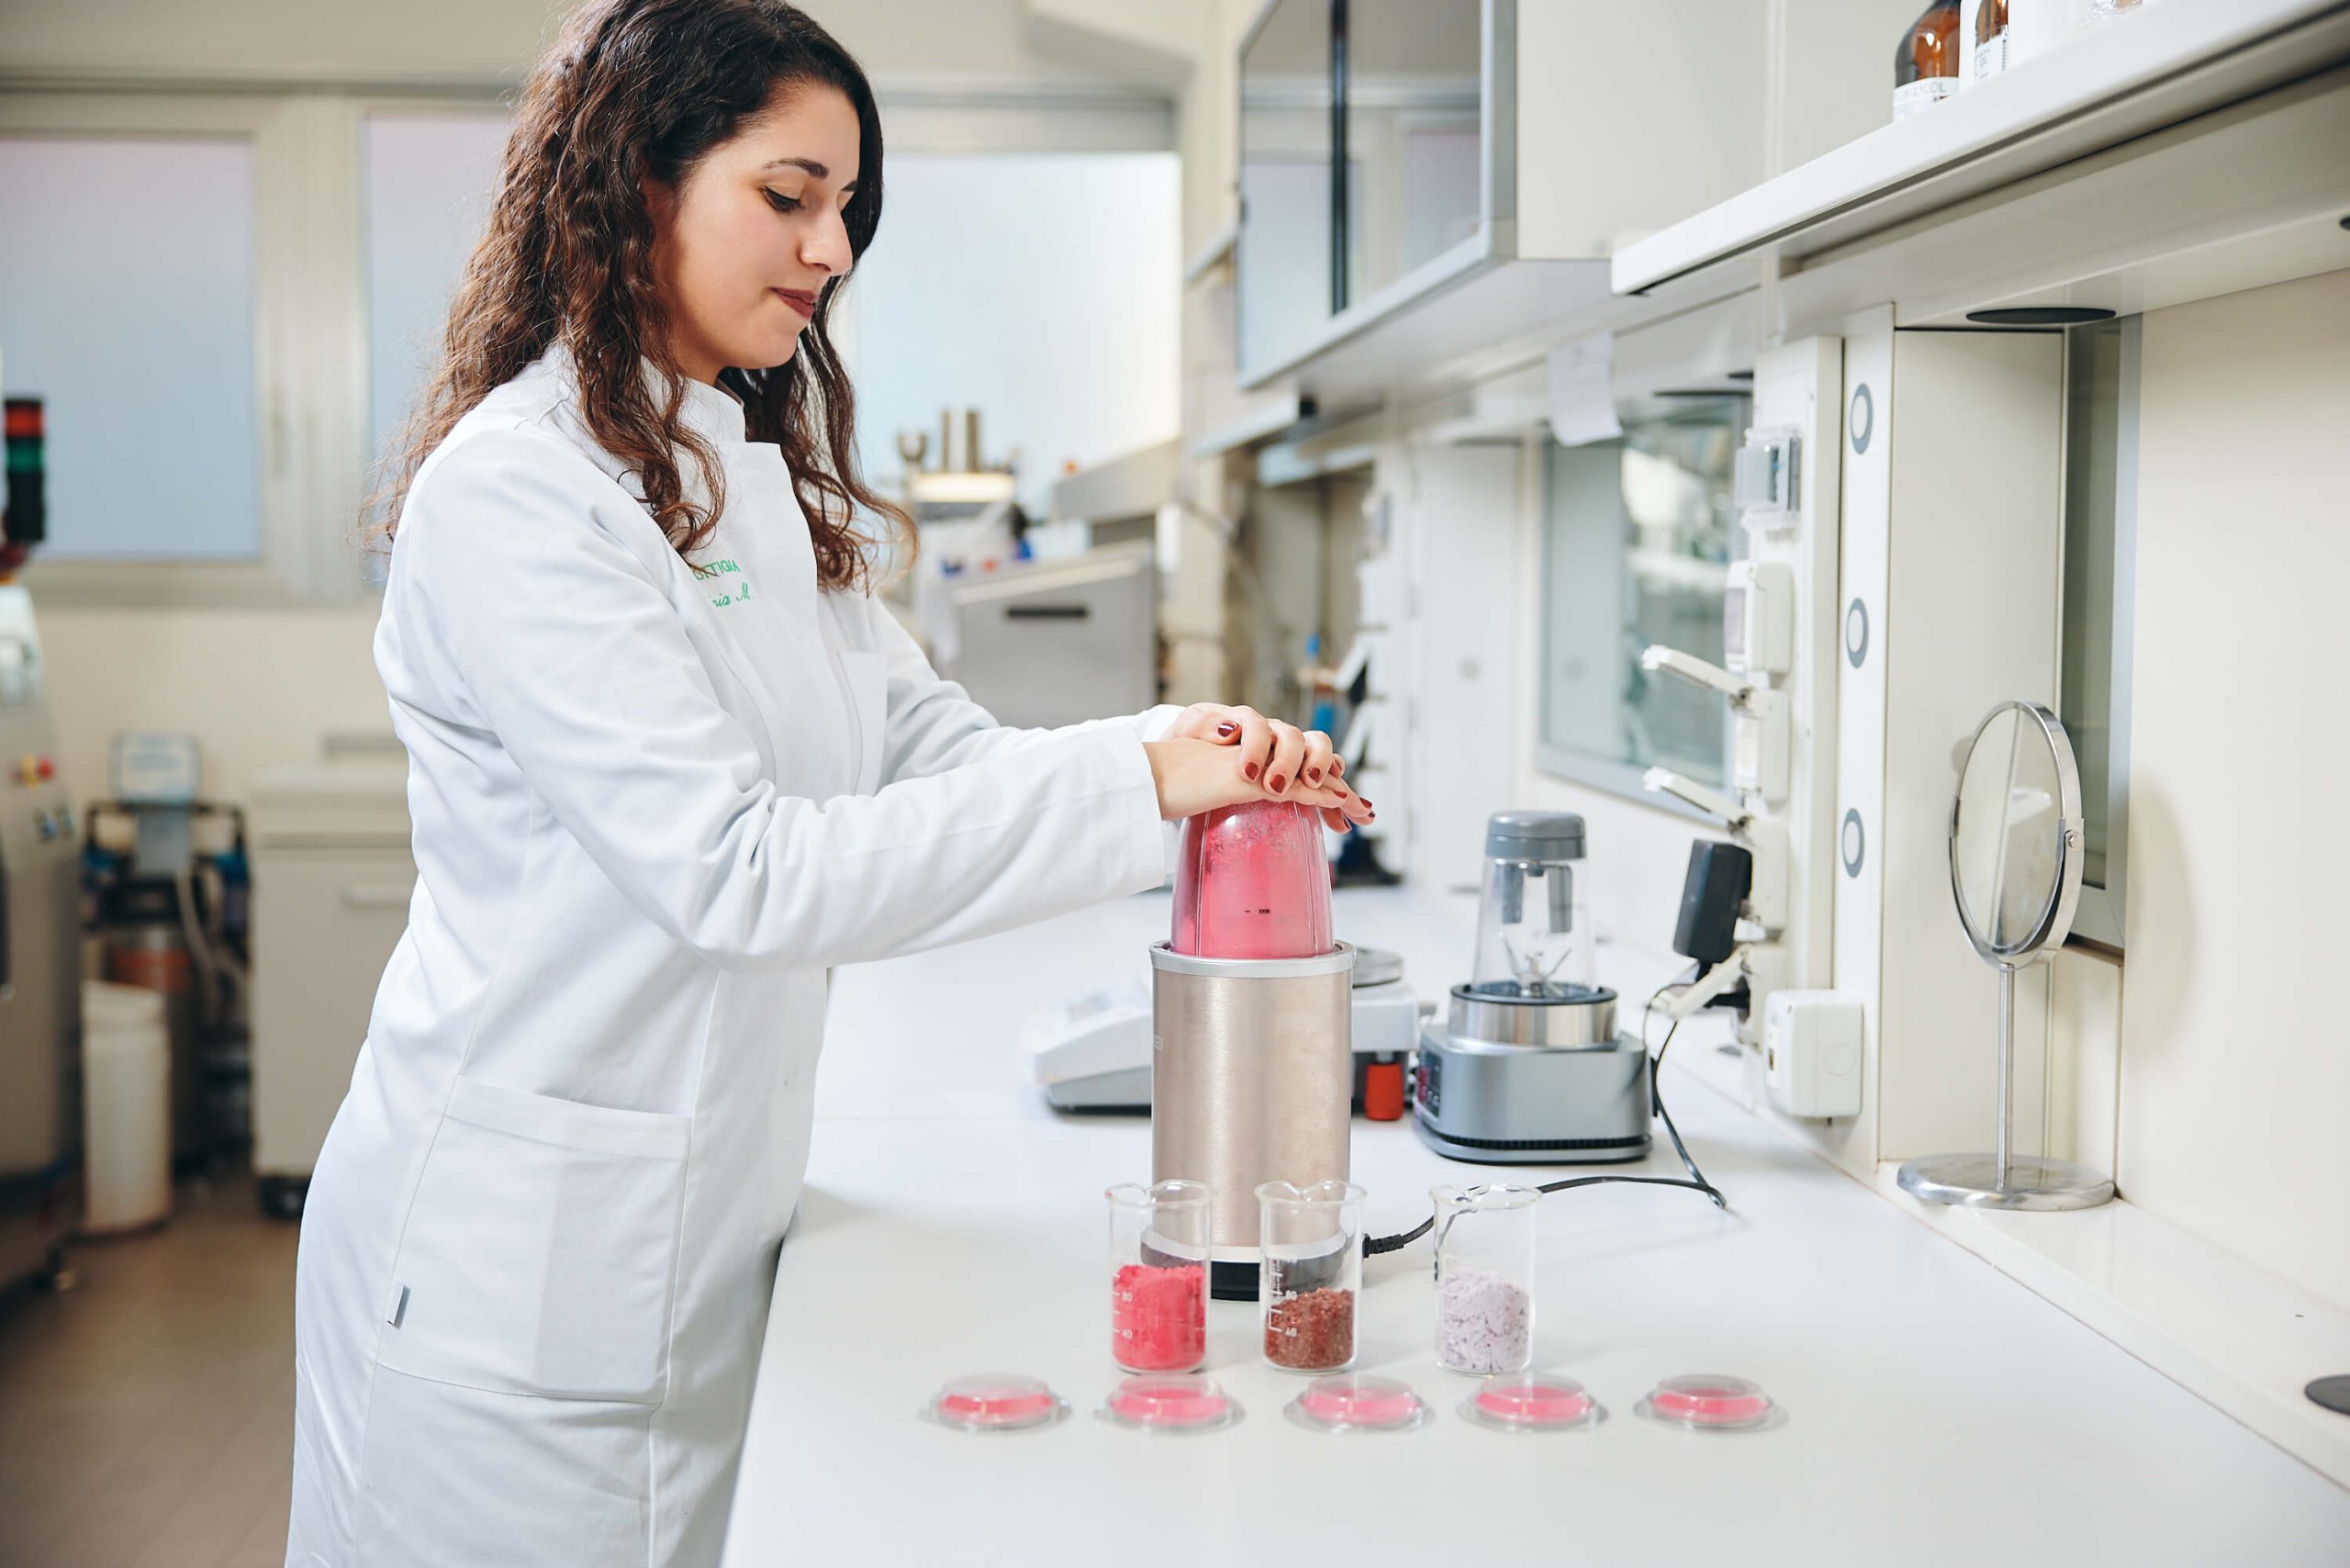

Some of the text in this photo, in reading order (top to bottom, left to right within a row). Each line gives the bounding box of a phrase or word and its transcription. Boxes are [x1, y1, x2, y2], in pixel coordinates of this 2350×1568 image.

[1123, 1291, 1133, 1302] 80
[1122, 1328, 1133, 1339] 40
[1285, 1327, 1297, 1338] 40
